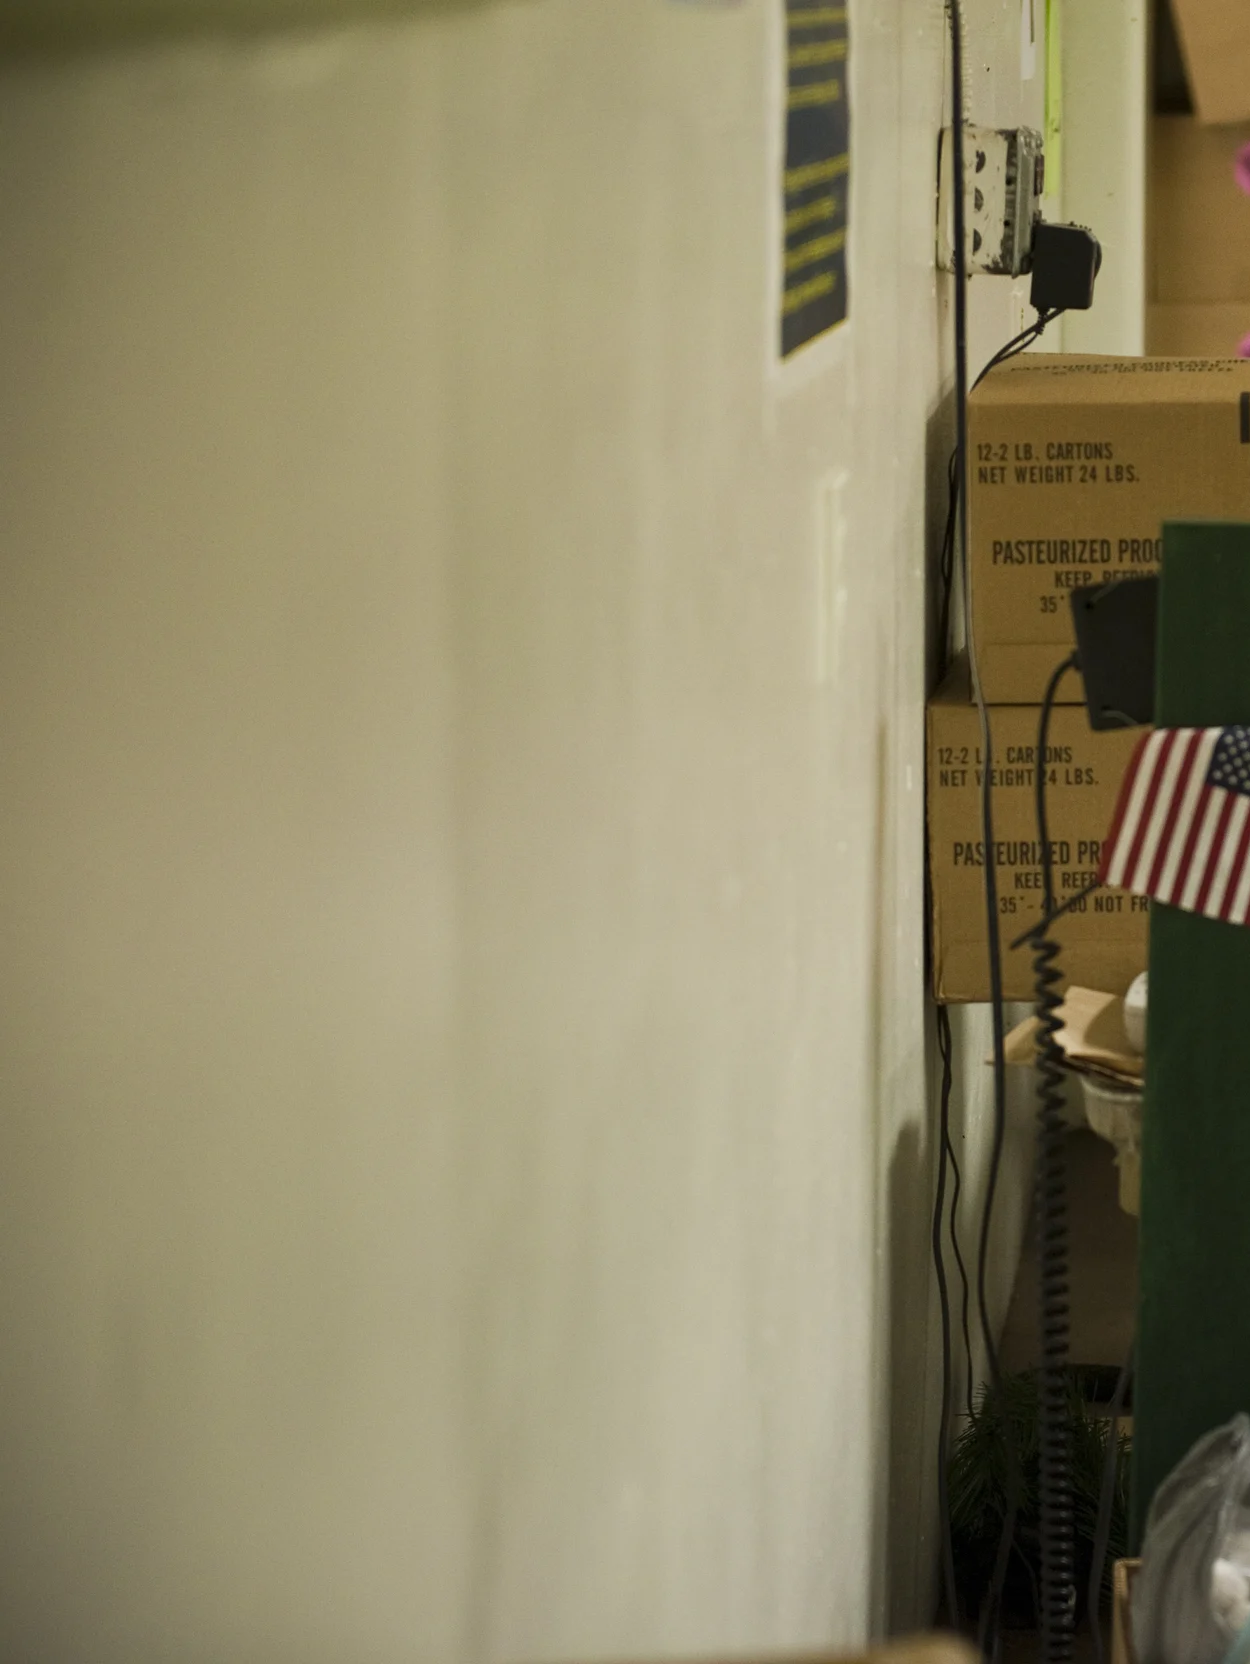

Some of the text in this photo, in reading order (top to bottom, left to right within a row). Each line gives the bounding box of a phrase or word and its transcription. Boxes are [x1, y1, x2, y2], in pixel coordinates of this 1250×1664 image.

[977, 442, 1113, 461] 12-2 LB. CARTONS
[977, 463, 1141, 484] NET WEIGHT 24 LBS.
[992, 538, 1163, 565] PASTEURIZED PROC
[1054, 570, 1093, 588] KEEP
[938, 746, 1073, 765] 12-2 L. CARONS
[939, 769, 967, 787] NET
[1065, 767, 1099, 786] LBS.
[953, 840, 1070, 866] PASEURIED
[1014, 872, 1048, 889] KEE
[1094, 895, 1124, 913] NOT
